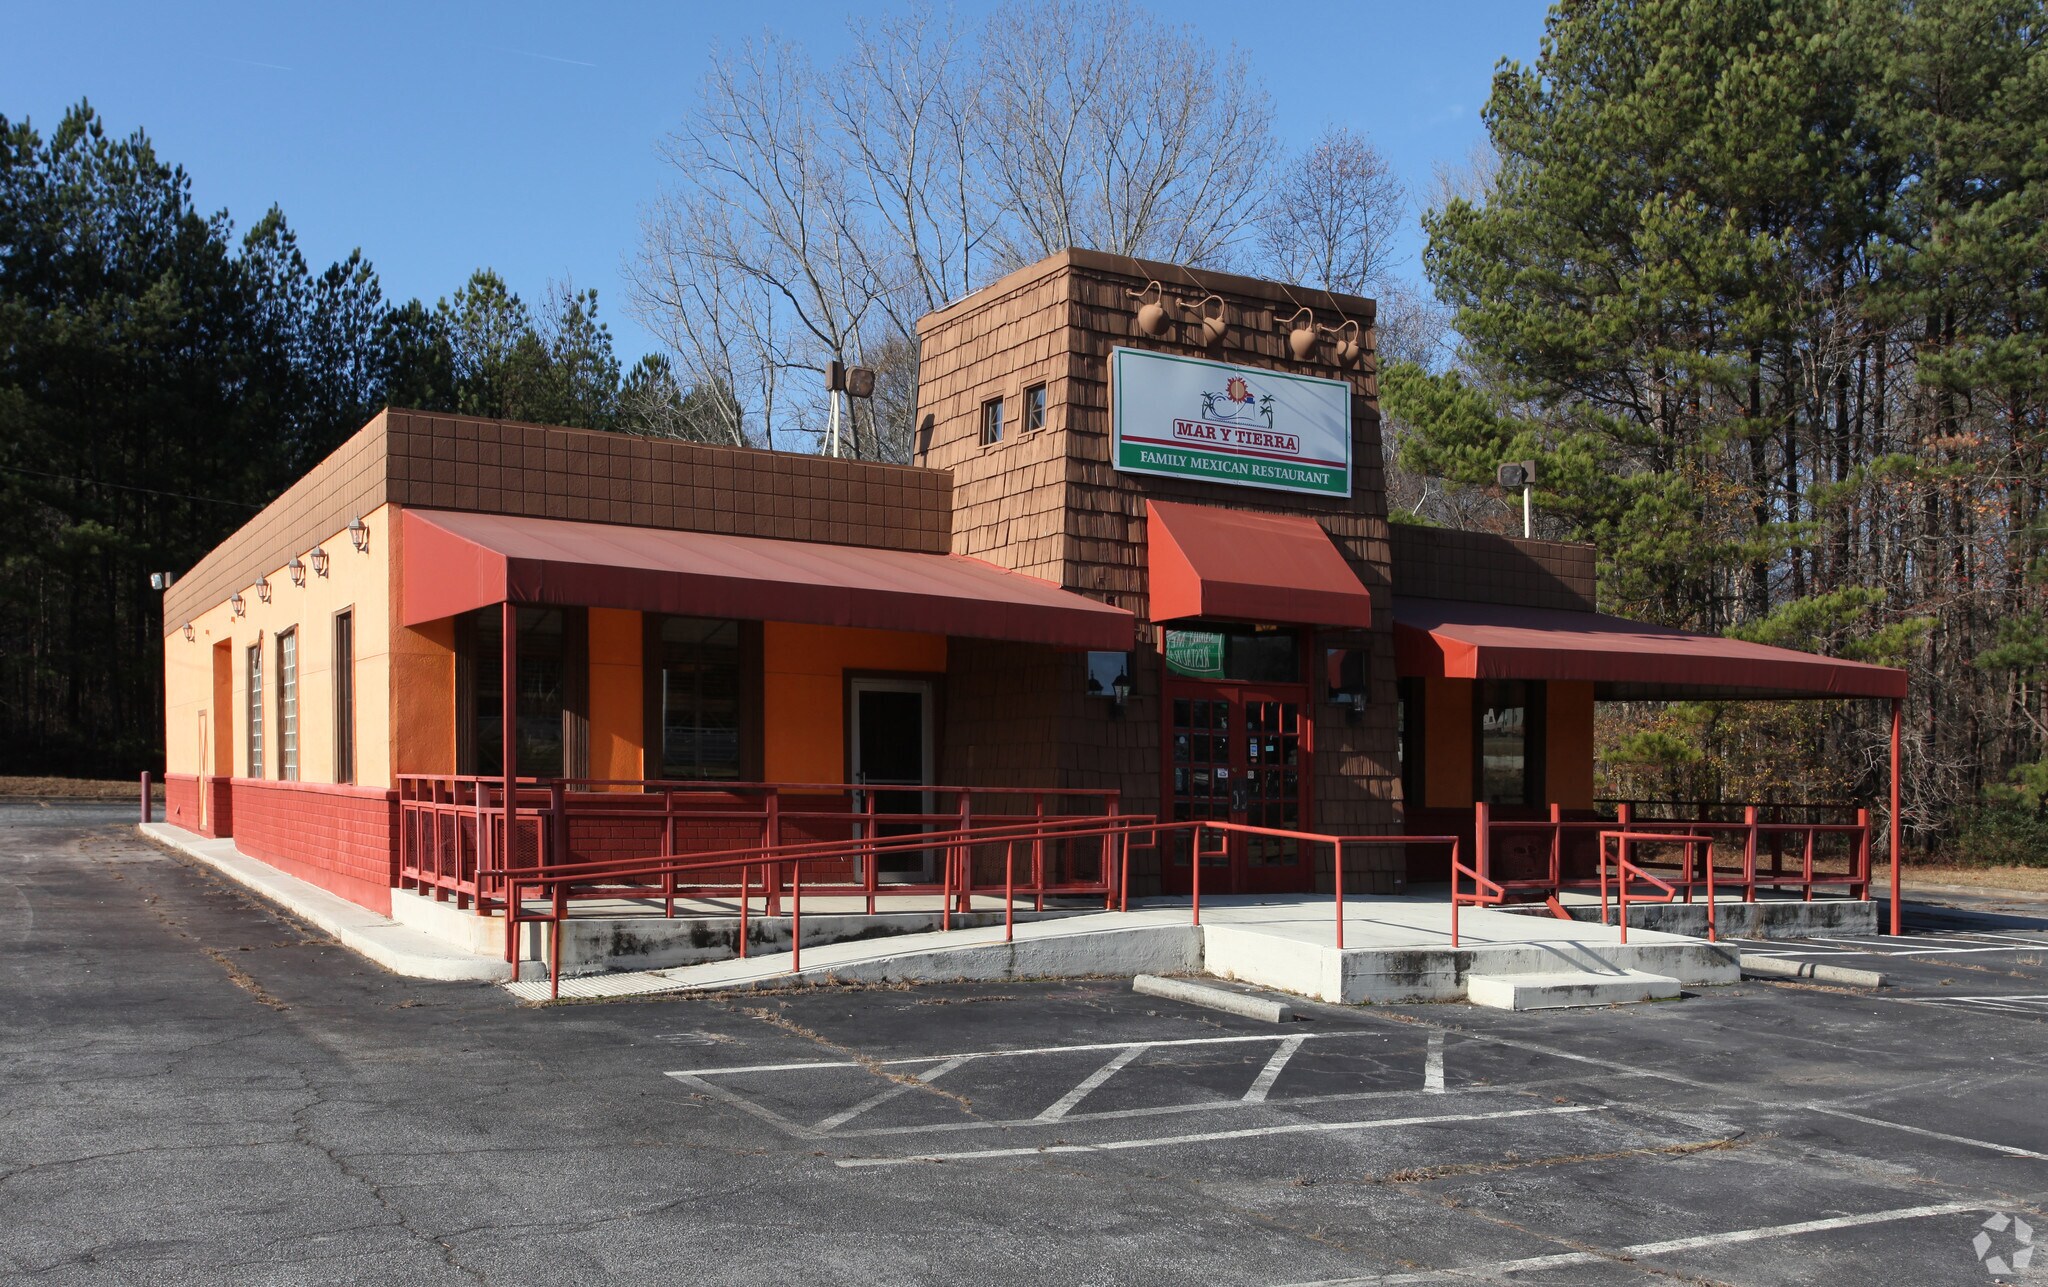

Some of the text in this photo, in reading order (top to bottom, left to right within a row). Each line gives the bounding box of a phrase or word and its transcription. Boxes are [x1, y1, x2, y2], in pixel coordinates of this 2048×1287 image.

[1177, 422, 1296, 450] MAR Y TIERRA
[1140, 451, 1330, 485] FAMILY MEXICAN RESTAURANT
